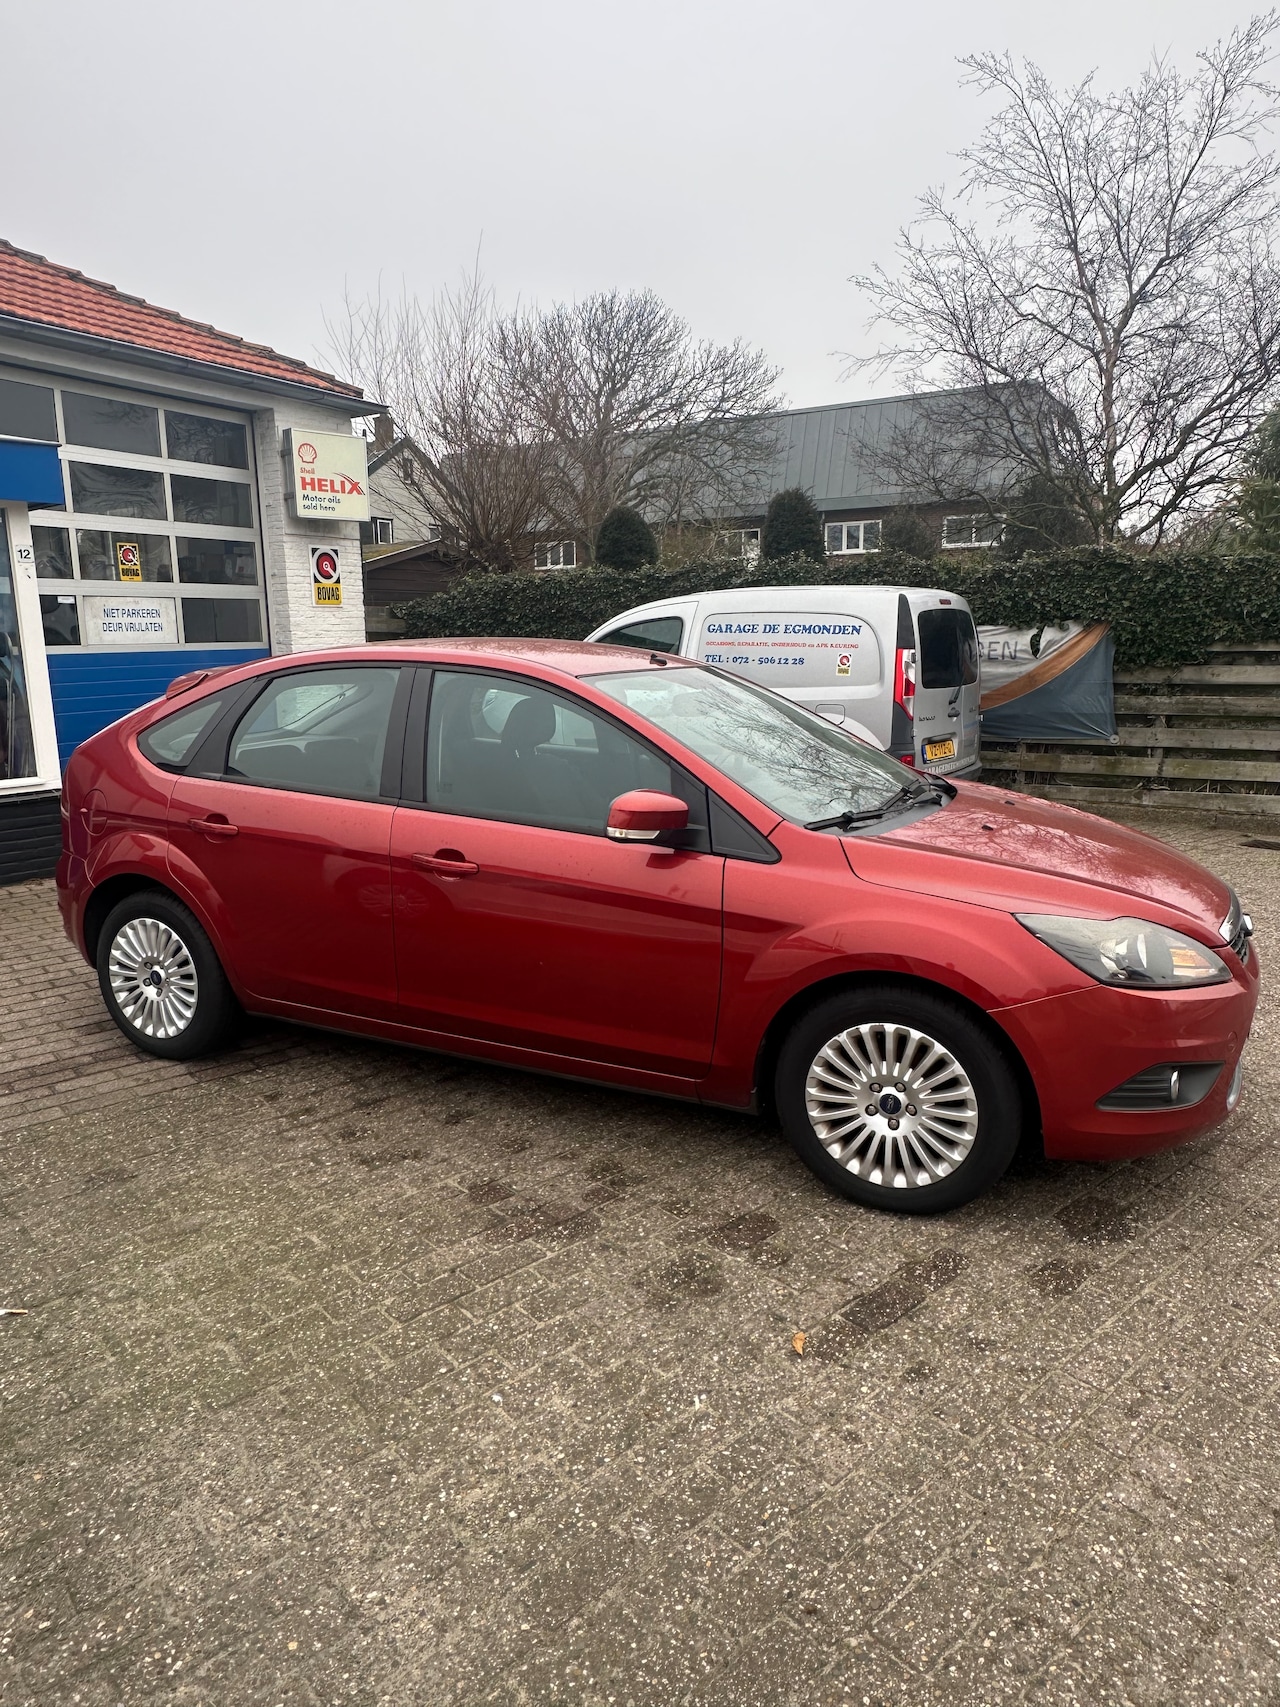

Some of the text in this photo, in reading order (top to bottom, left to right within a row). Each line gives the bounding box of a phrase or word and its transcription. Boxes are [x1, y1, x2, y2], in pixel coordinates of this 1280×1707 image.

[300, 466, 315, 475] Shell
[300, 476, 364, 495] HELIX
[302, 494, 341, 504] Motor oils
[303, 503, 336, 512] sold here
[17, 549, 31, 559] 12
[121, 567, 140, 577] BOVAG
[317, 587, 340, 601] BOVAG
[103, 608, 161, 619] NIET PARKEREN
[102, 622, 123, 632] DEUR
[707, 623, 863, 636] GARAGE DE EGMONDEN
[705, 654, 724, 664] TEL
[732, 656, 750, 665] 072
[758, 656, 776, 665] 506
[777, 657, 789, 665] 12
[791, 657, 805, 665] 28
